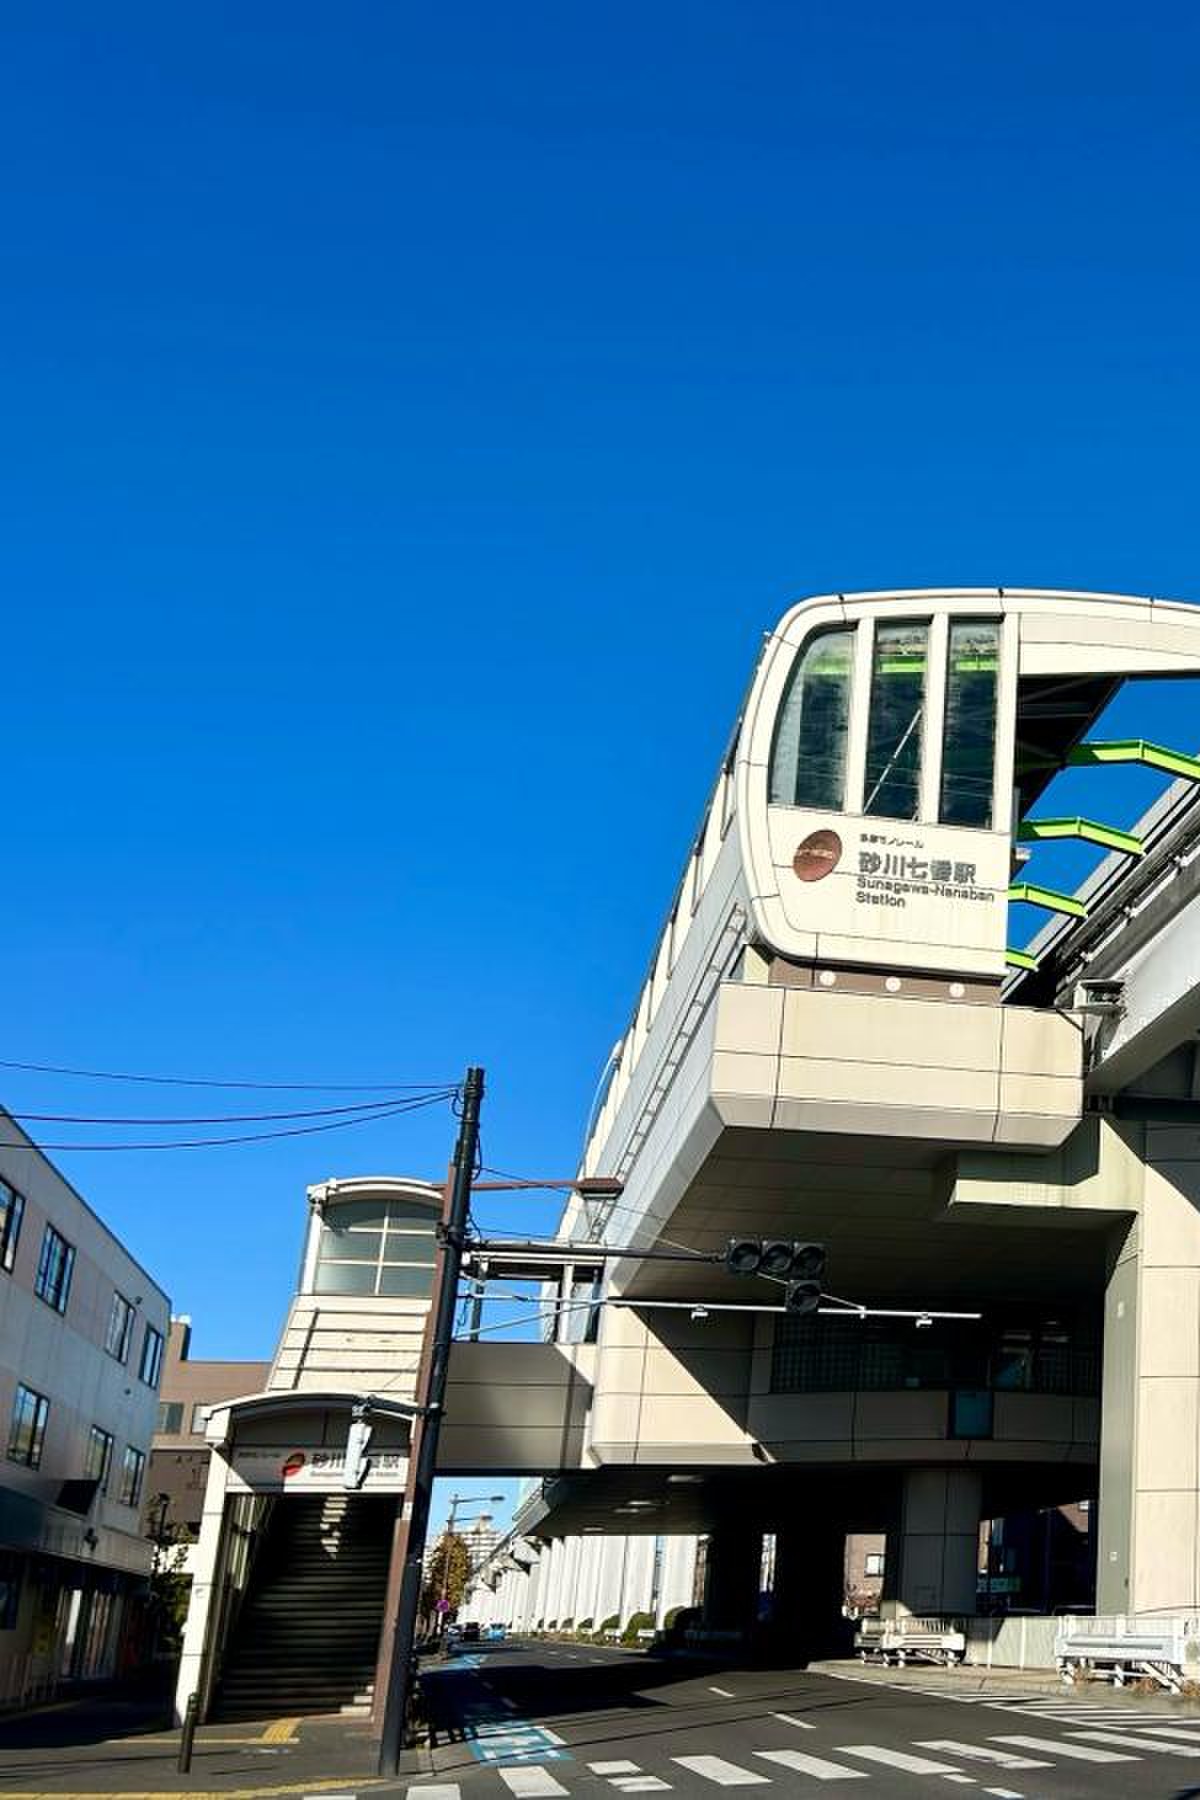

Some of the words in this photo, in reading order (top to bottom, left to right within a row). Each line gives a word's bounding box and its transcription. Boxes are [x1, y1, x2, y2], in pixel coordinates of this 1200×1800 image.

[858, 852, 976, 884] 砂川七番駅
[856, 891, 906, 908] Station
[857, 877, 995, 902] Sunagawa-Nanaban
